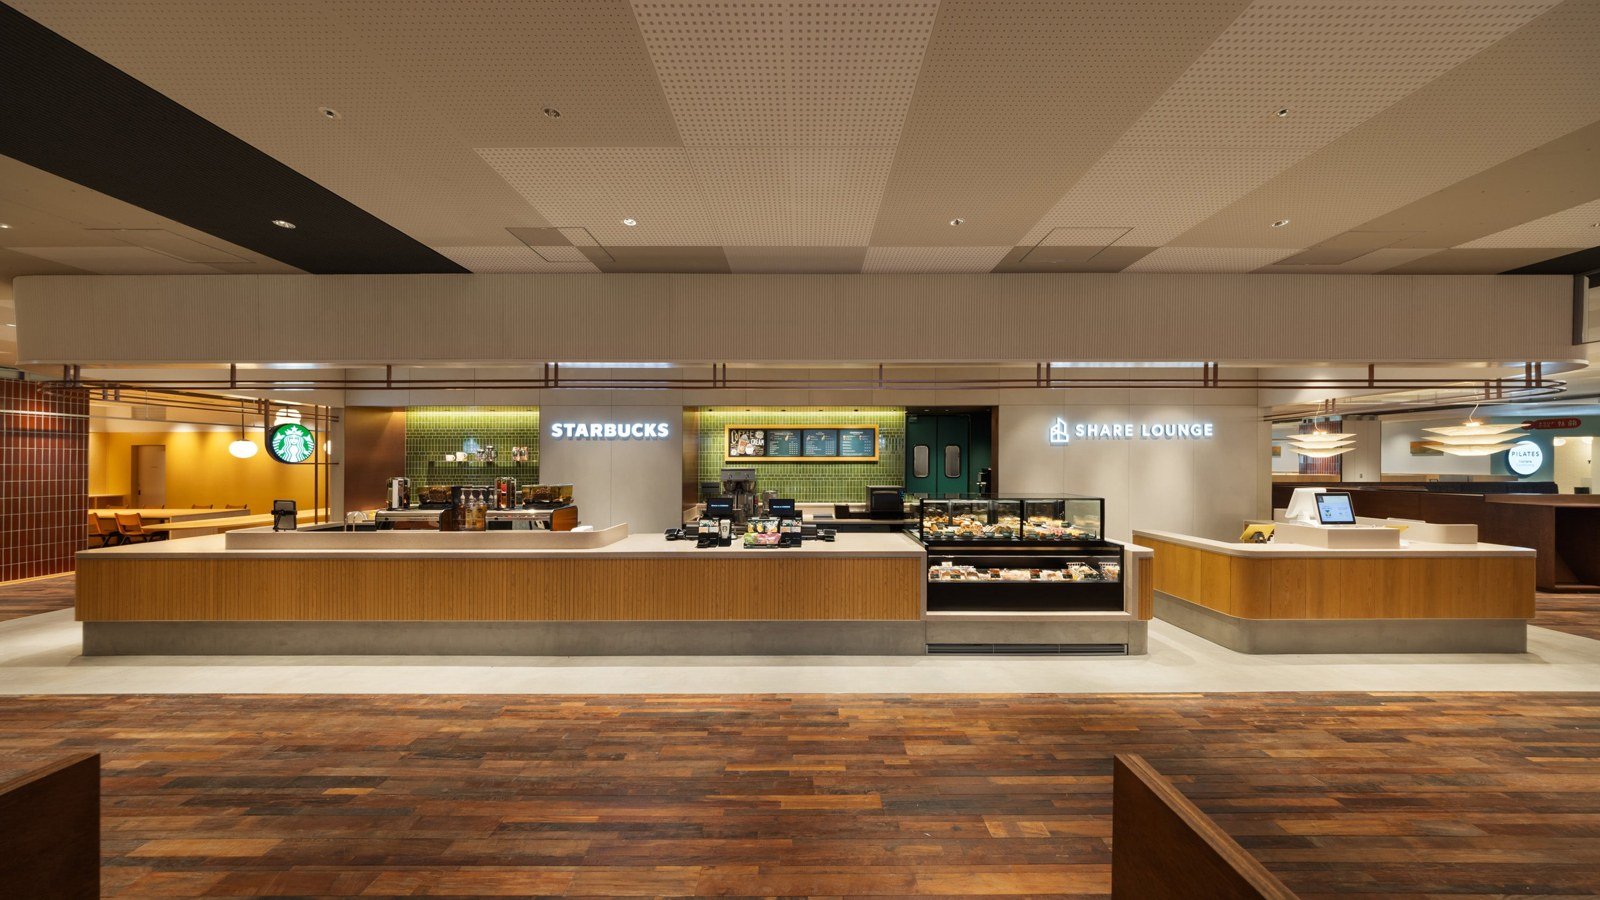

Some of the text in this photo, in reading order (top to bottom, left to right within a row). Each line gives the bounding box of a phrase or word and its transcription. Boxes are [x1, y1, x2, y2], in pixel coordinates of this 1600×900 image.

[551, 422, 669, 438] STARBUCKS
[1075, 423, 1213, 437] SHARE LOUNGE
